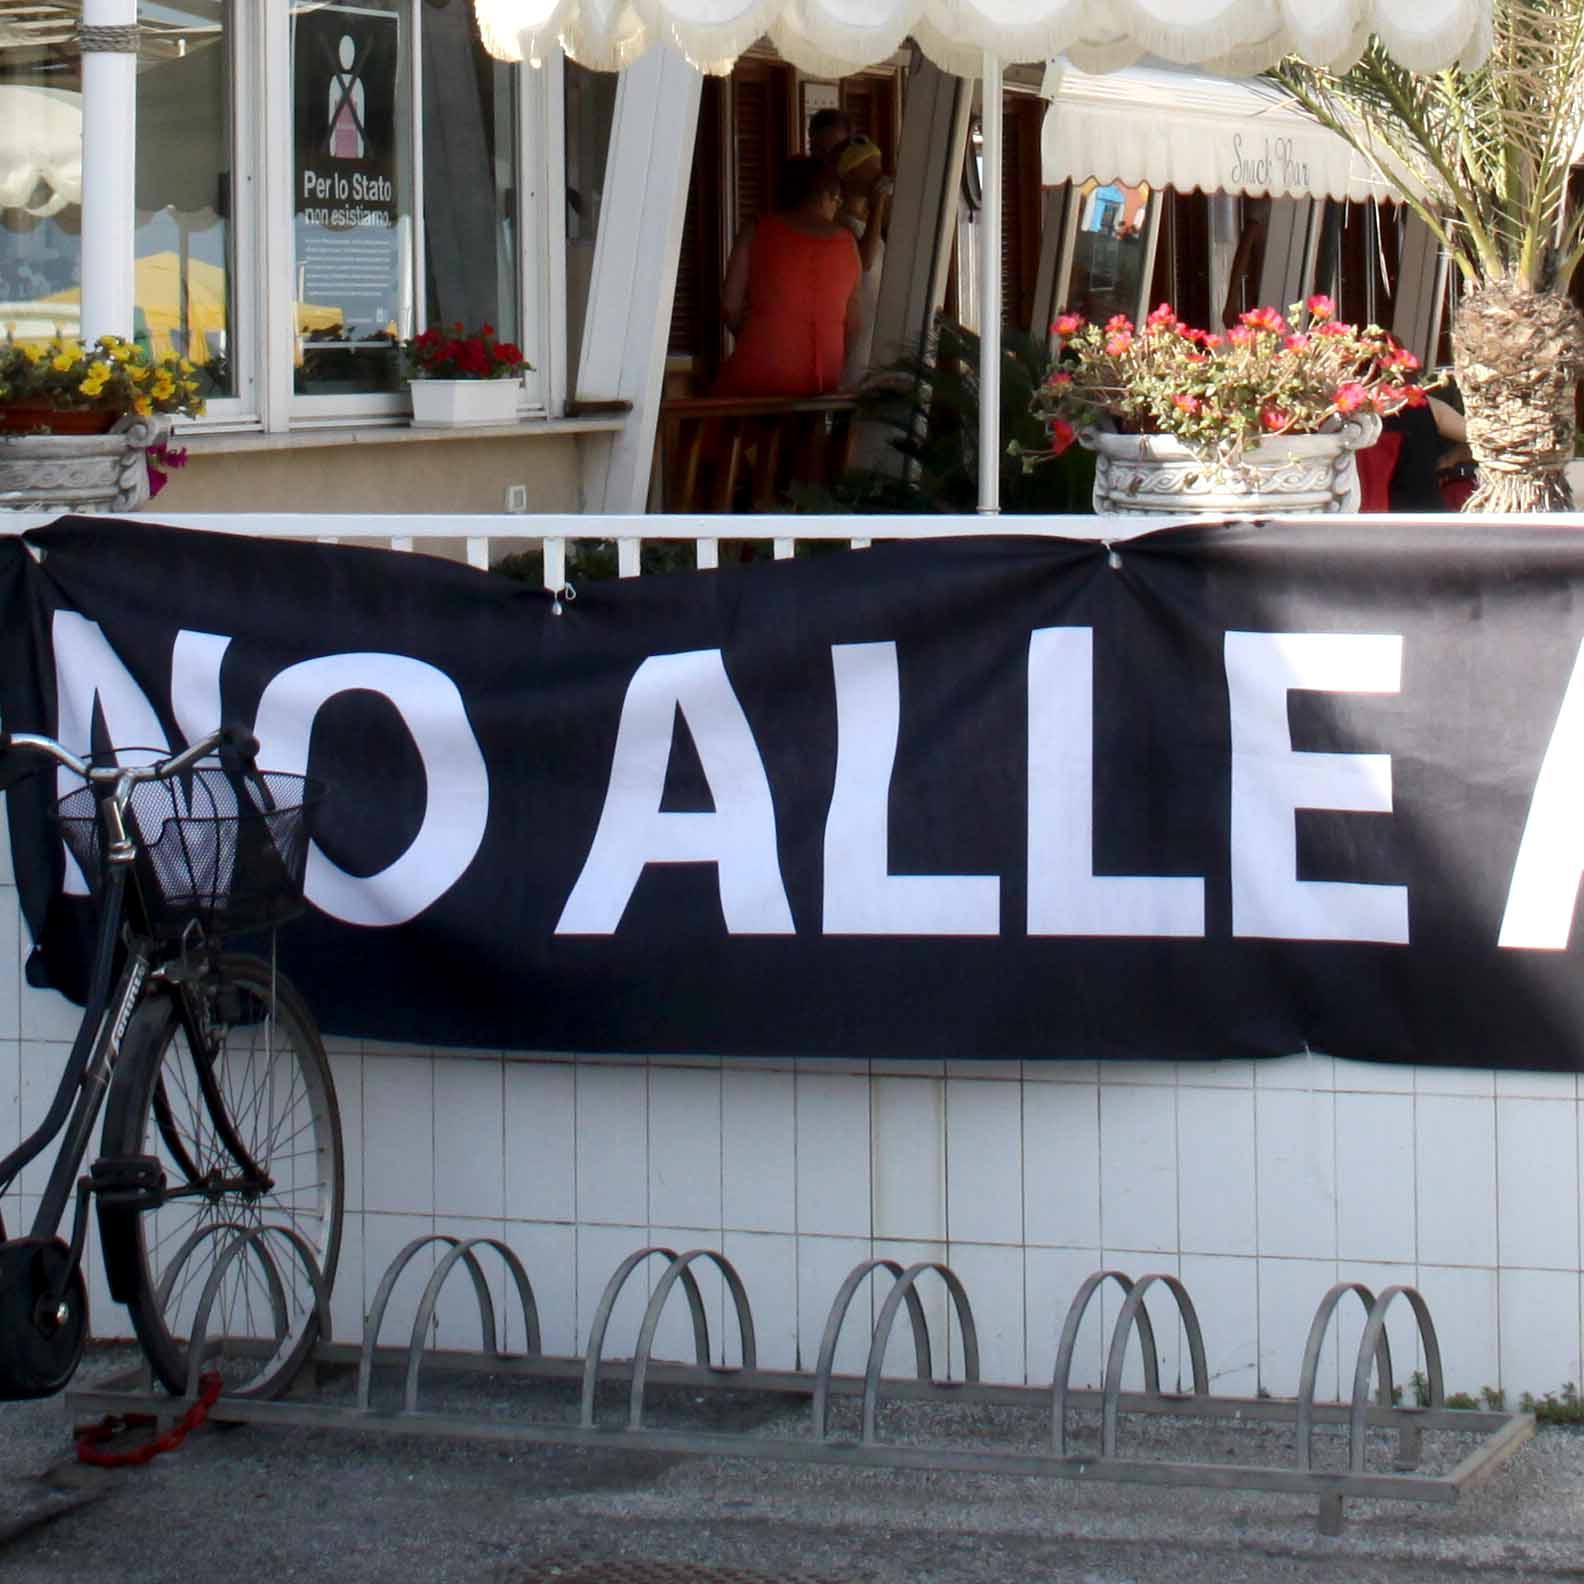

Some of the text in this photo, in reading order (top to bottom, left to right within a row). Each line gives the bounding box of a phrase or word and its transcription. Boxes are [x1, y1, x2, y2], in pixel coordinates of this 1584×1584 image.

[1231, 132, 1311, 186] Snack Bar
[304, 170, 392, 202] Per lo Stato
[304, 204, 392, 228] non esistiamo.
[50, 606, 492, 929] NO
[553, 626, 1409, 940] ALLE
